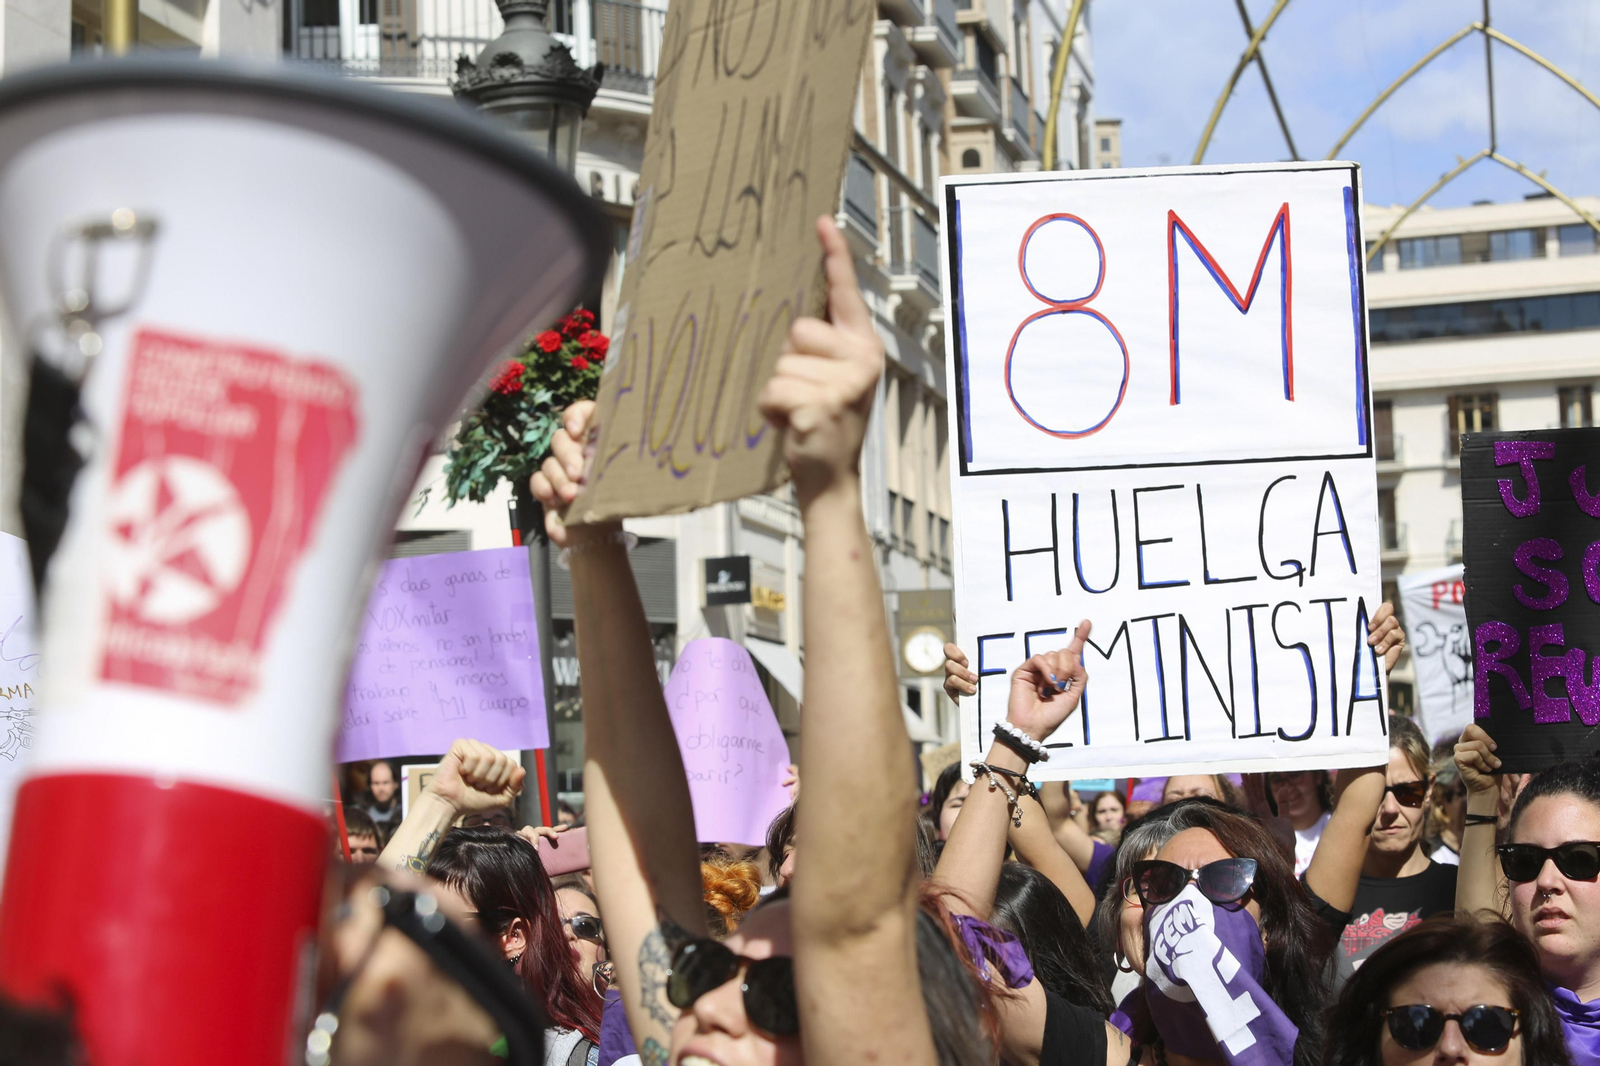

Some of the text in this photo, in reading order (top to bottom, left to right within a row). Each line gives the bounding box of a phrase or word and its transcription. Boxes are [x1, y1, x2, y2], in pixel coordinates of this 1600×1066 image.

[1004, 203, 1295, 440] 8M
[1002, 470, 1357, 601] HUELGA
[444, 569, 488, 598] ganas
[494, 560, 511, 580] de
[356, 642, 371, 655] os
[437, 638, 454, 651] no
[461, 633, 482, 648] son
[378, 656, 397, 674] de
[455, 670, 509, 687] menos
